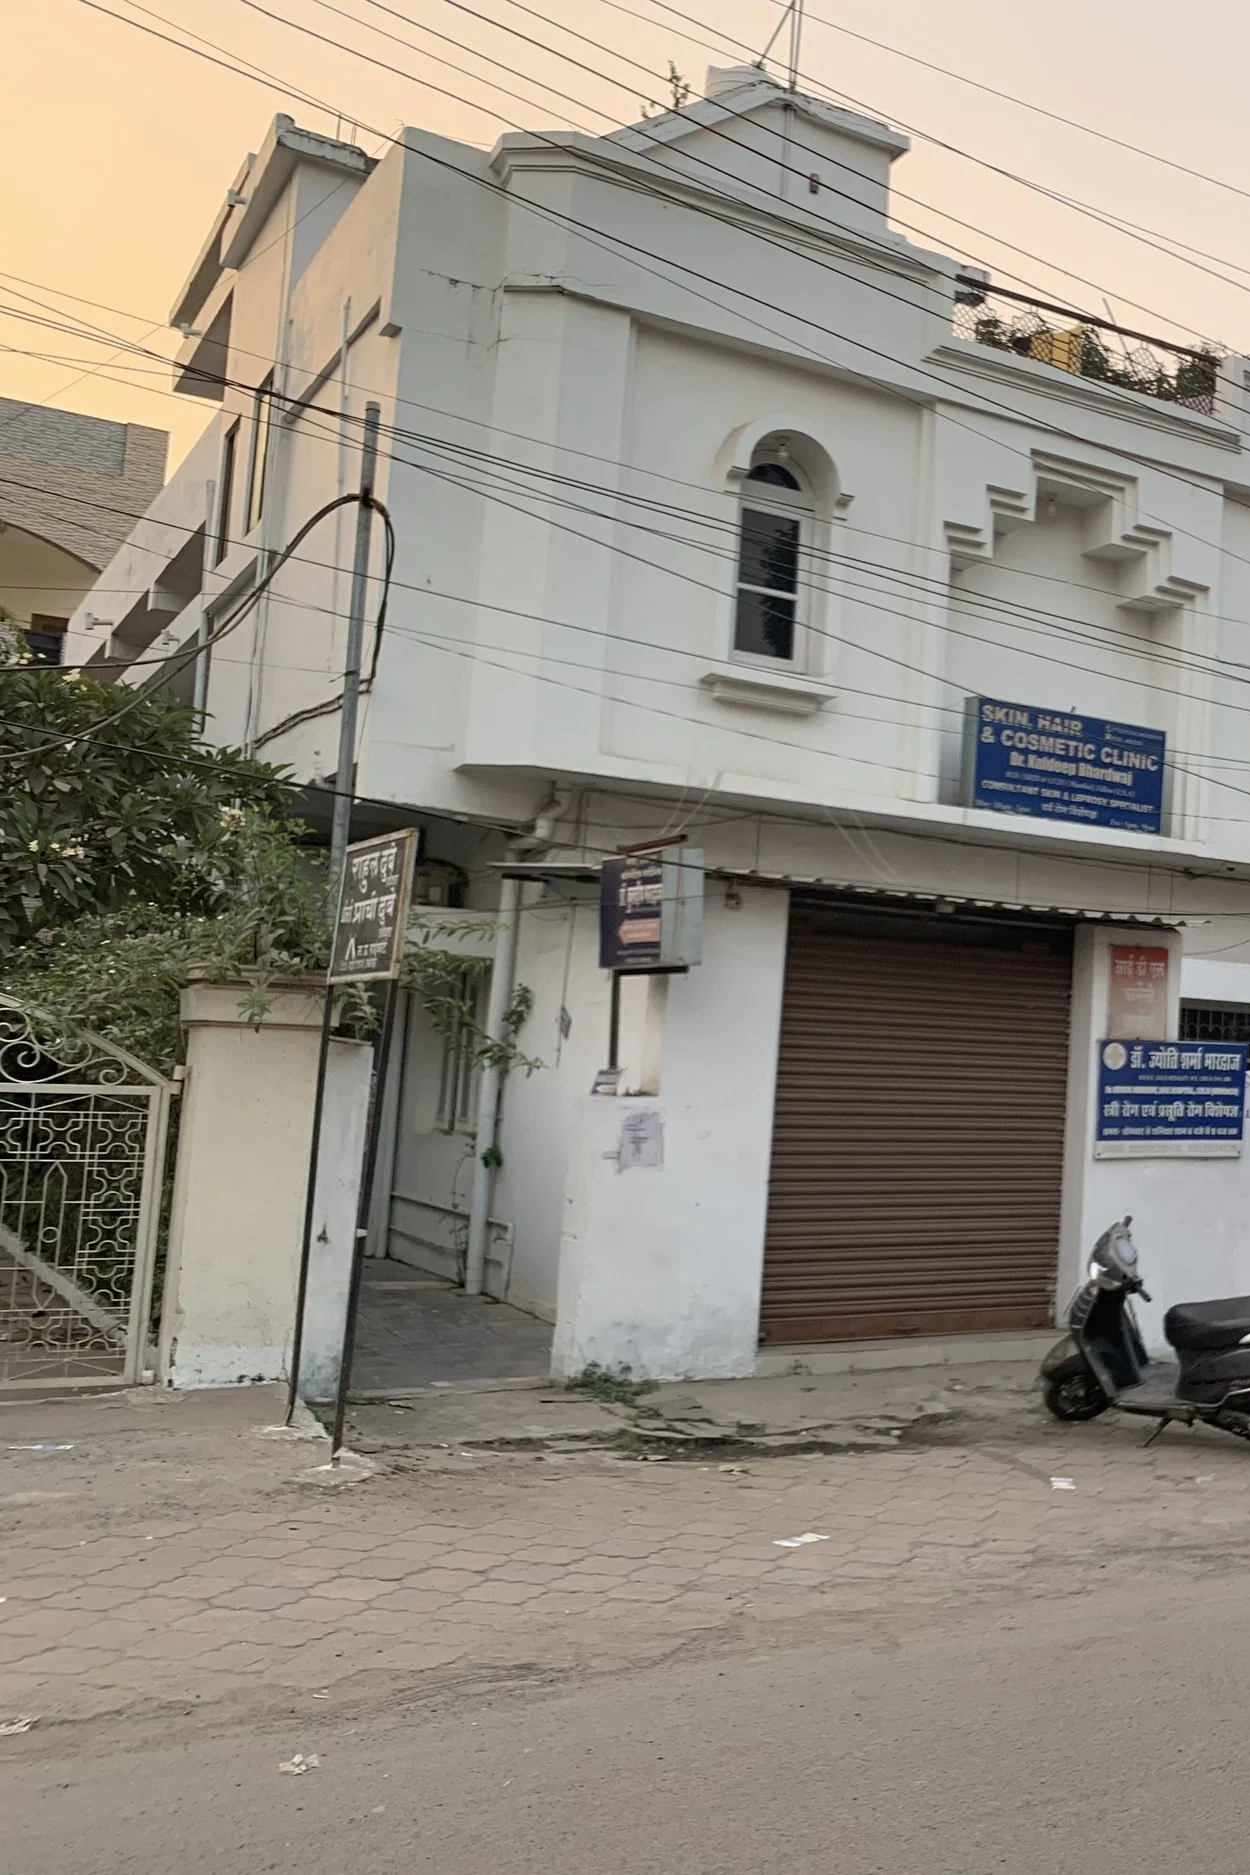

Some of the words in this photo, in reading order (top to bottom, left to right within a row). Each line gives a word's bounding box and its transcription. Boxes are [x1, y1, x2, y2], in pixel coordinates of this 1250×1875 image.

[1037, 714, 1082, 735] HAIR
[981, 726, 995, 743] &
[1001, 730, 1096, 760] COSMETIC
[1101, 747, 1159, 772] CLINIC
[352, 852, 380, 893] राहुल
[379, 842, 397, 883] दुबे
[378, 887, 397, 926] दुबे
[1130, 1046, 1146, 1069] डॉ.
[1148, 1047, 1179, 1070] ज्योति
[1181, 1047, 1203, 1070] शर्मा
[1205, 1053, 1242, 1071] भारद्वाज
[1121, 1100, 1140, 1118] रोग
[1141, 1101, 1157, 1118] एवं
[1187, 1101, 1204, 1118] रोग
[1205, 1101, 1240, 1118] विशेषज्ञ
